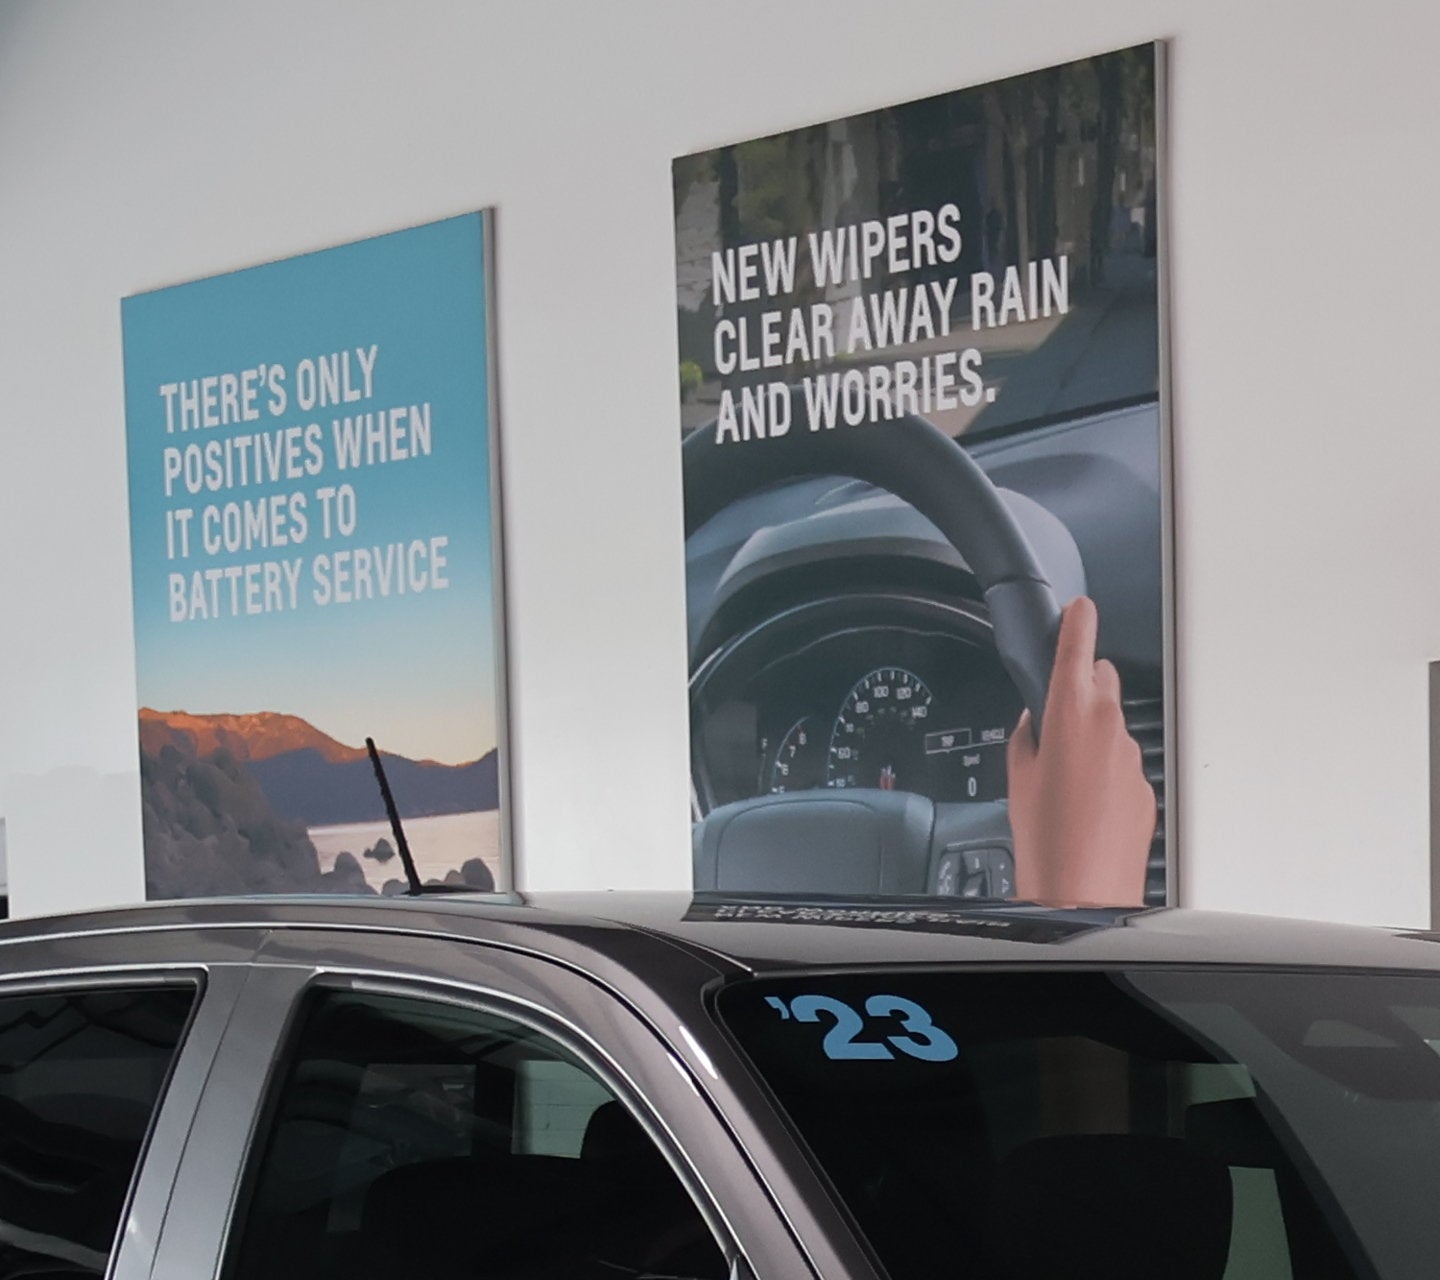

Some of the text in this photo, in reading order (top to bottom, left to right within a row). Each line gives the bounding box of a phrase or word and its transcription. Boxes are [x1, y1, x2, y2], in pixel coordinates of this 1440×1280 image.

[711, 203, 961, 306] NEW WIPERS
[714, 255, 1069, 375] CLEAR AWAY RAIN
[160, 344, 378, 433] THERE'S ONLY
[715, 348, 997, 444] AND WORRIES.
[163, 403, 432, 496] POSITIVES WHEN
[166, 483, 357, 559] IT COMES TO
[168, 536, 449, 622] BATTERY SERVICE
